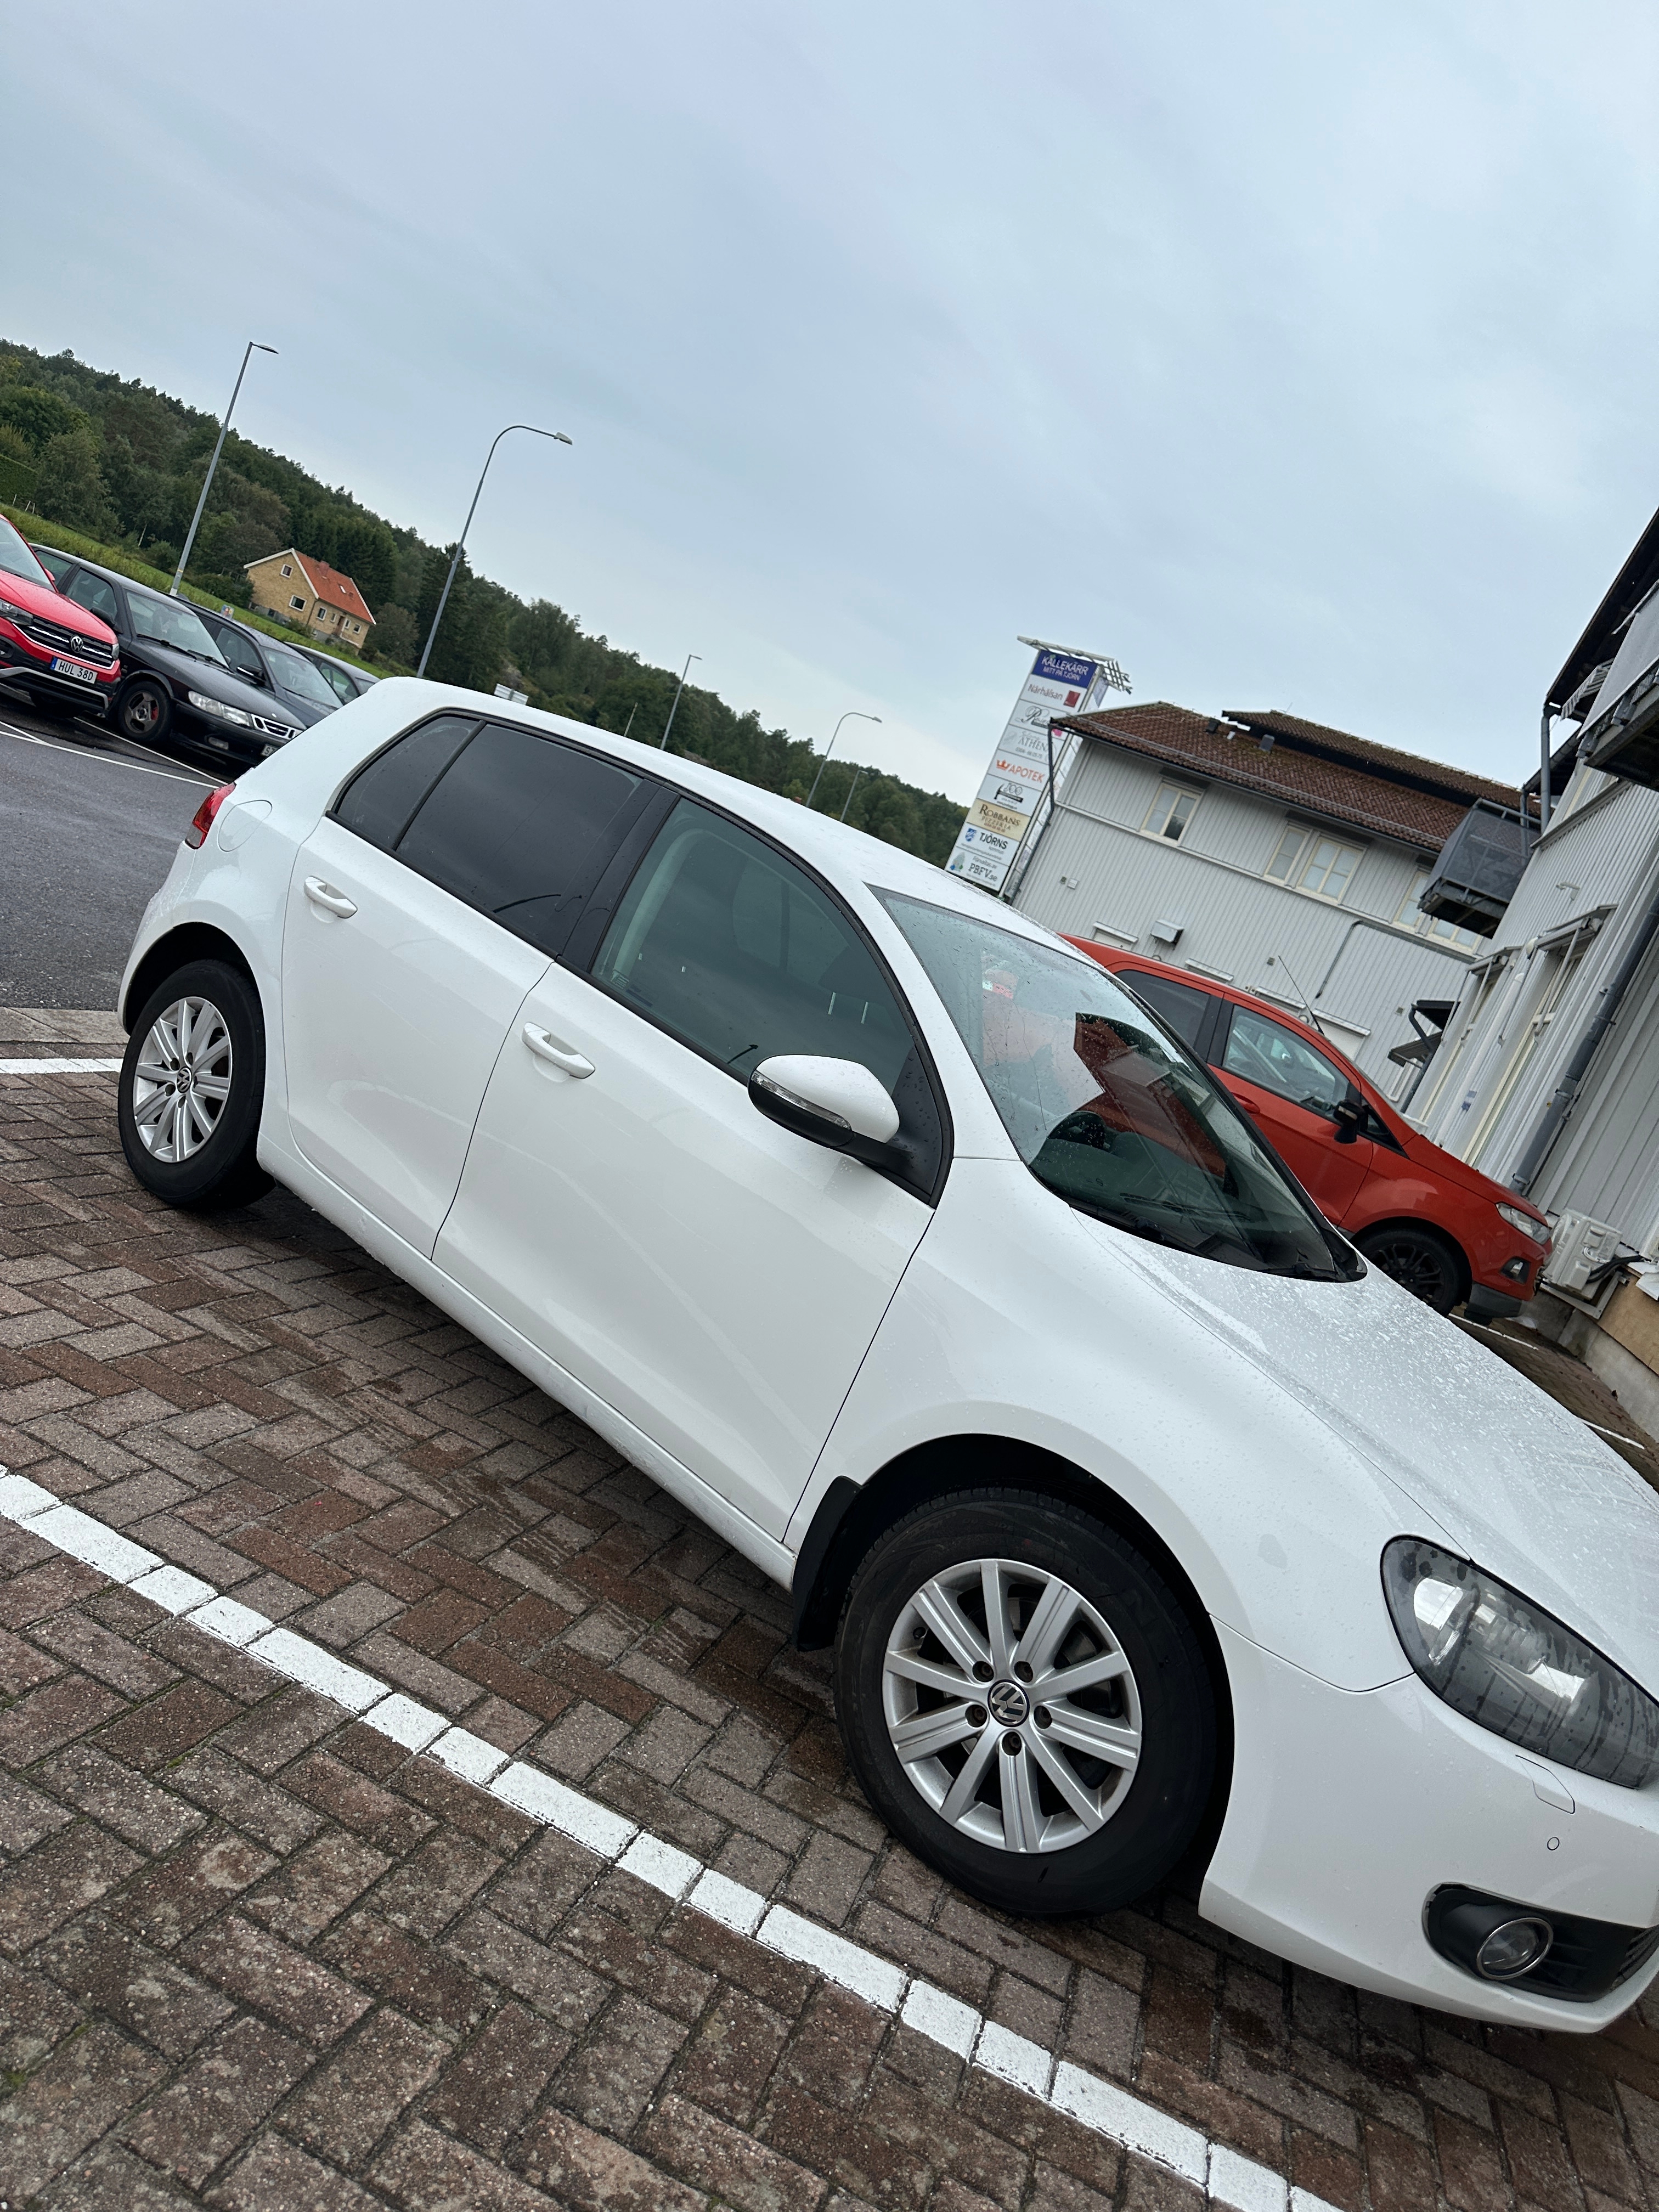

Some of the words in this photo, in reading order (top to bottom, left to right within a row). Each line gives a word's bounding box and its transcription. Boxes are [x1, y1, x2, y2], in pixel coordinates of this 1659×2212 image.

[58, 661, 74, 675] HUL
[77, 668, 93, 681] 38D
[1028, 684, 1063, 700] Närhälsan
[1008, 764, 1046, 783] APOTEK
[979, 804, 1021, 826] ROBBANS
[979, 832, 1008, 849] TJÖRNS
